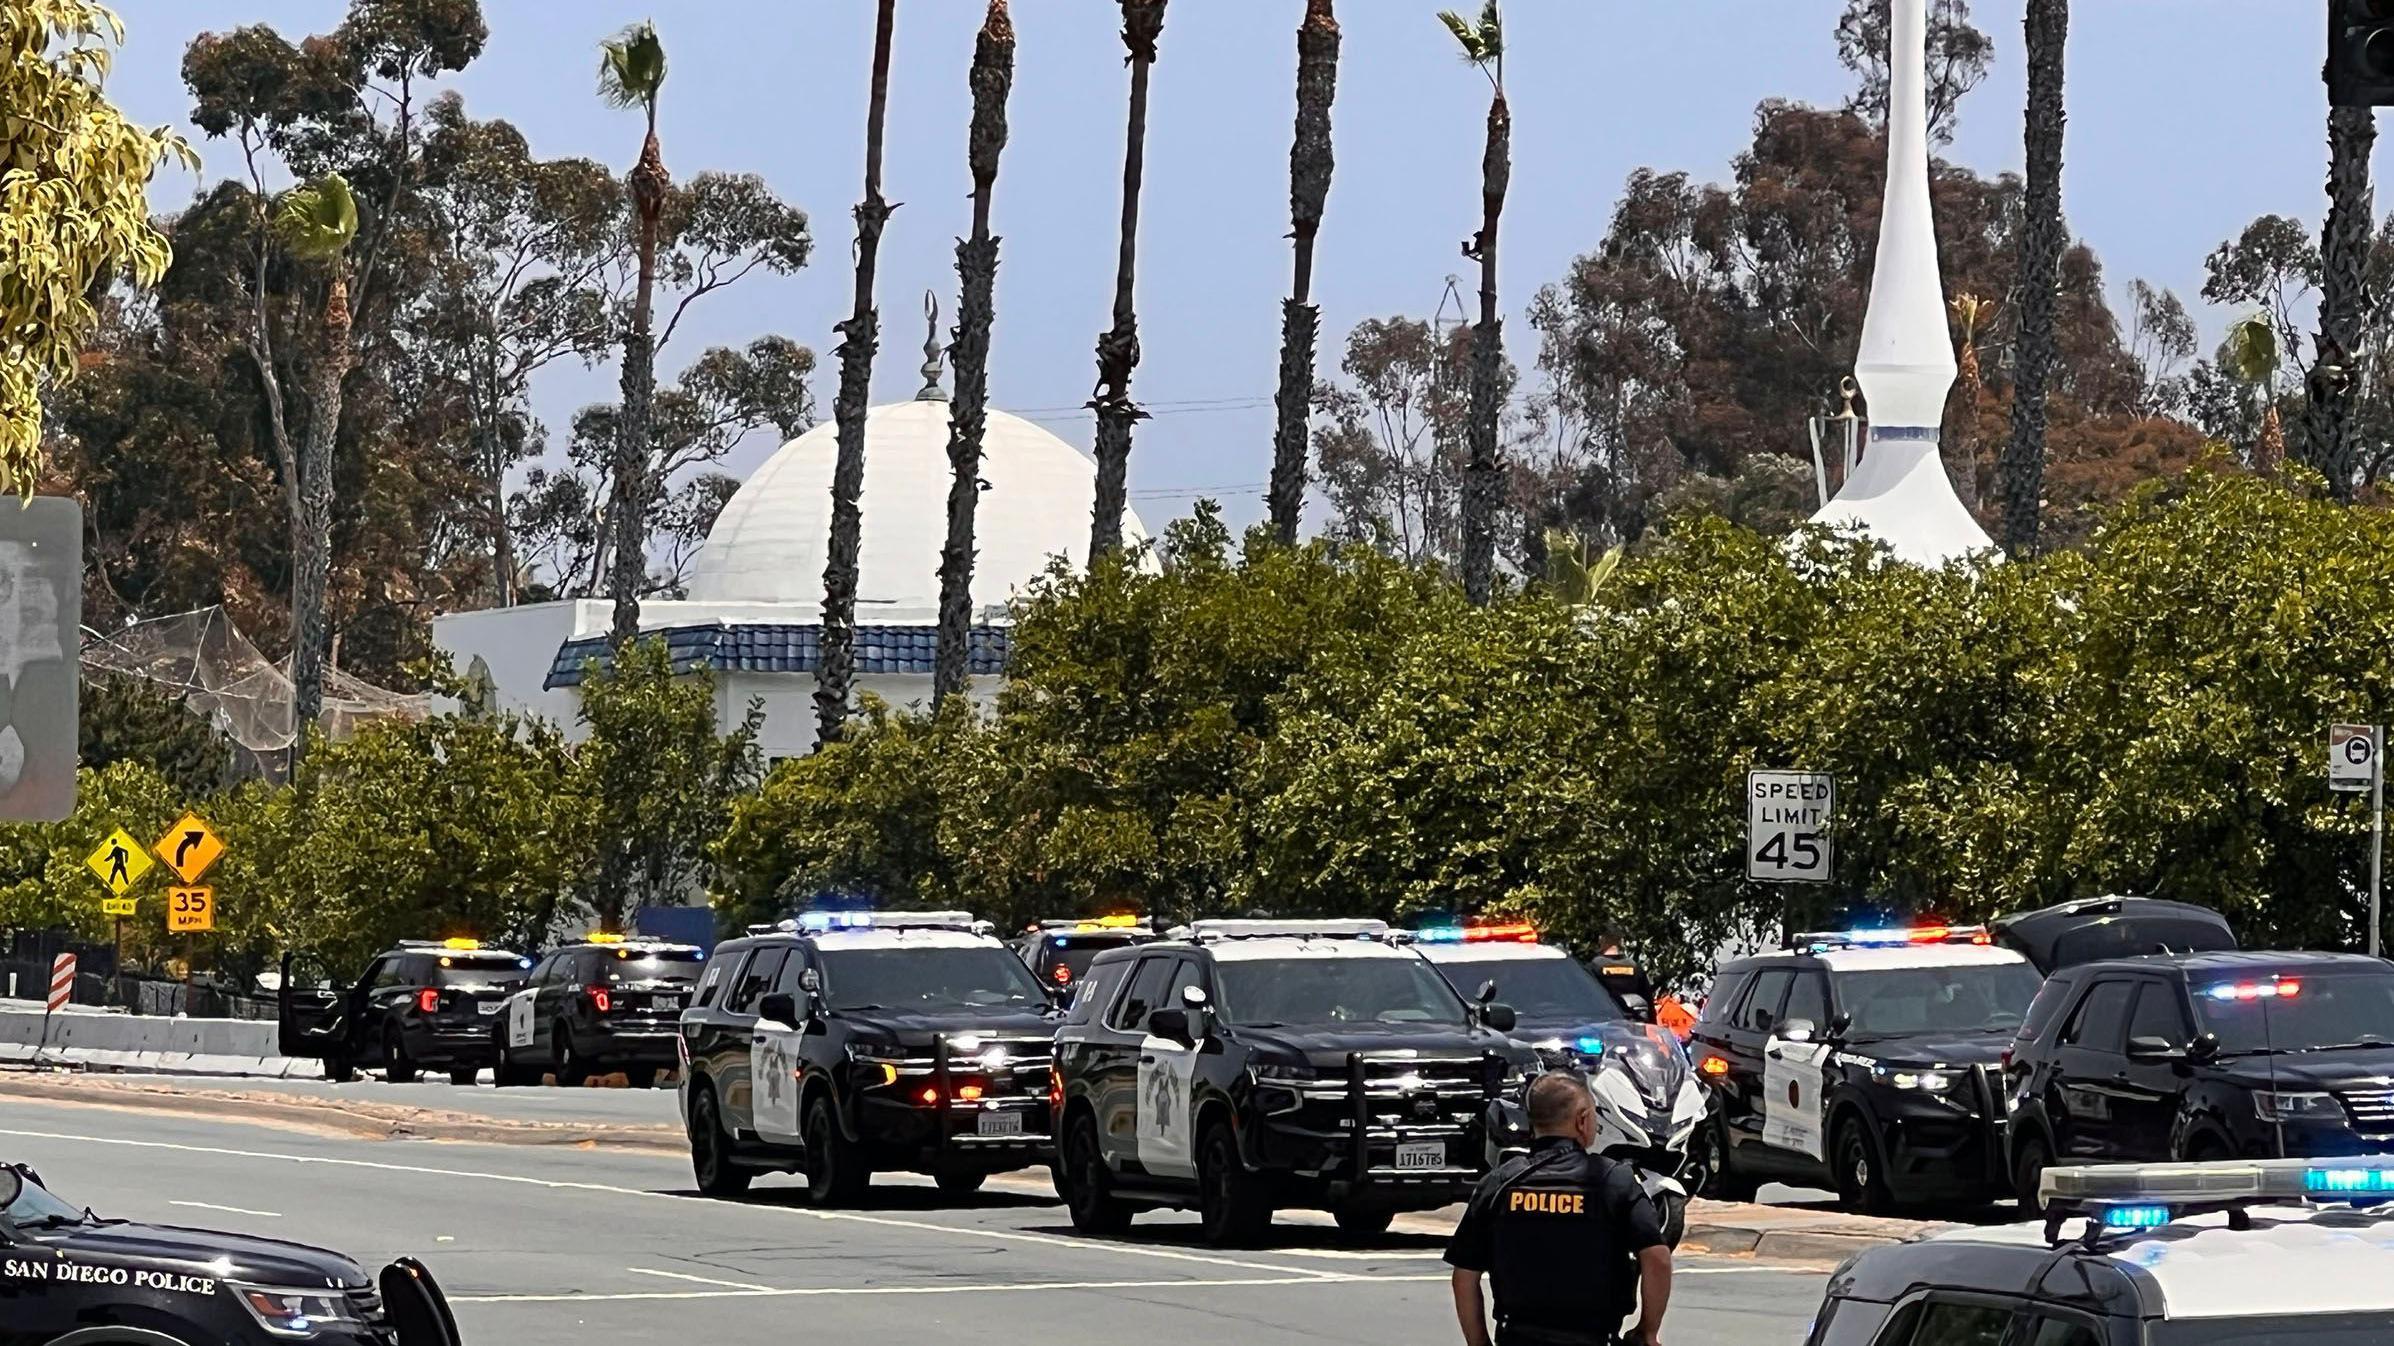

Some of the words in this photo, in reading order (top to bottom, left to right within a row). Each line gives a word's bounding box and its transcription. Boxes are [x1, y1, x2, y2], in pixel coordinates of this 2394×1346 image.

[1755, 783, 1829, 800] SPEED
[1761, 807, 1821, 825] LIMIT
[1755, 831, 1821, 870] 45
[174, 892, 206, 912] 35
[178, 916, 203, 925] MPH
[1510, 1191, 1585, 1214] POLICE
[4, 1259, 49, 1280] SAN
[56, 1262, 129, 1285] DIEGO
[134, 1270, 216, 1296] POLICE
